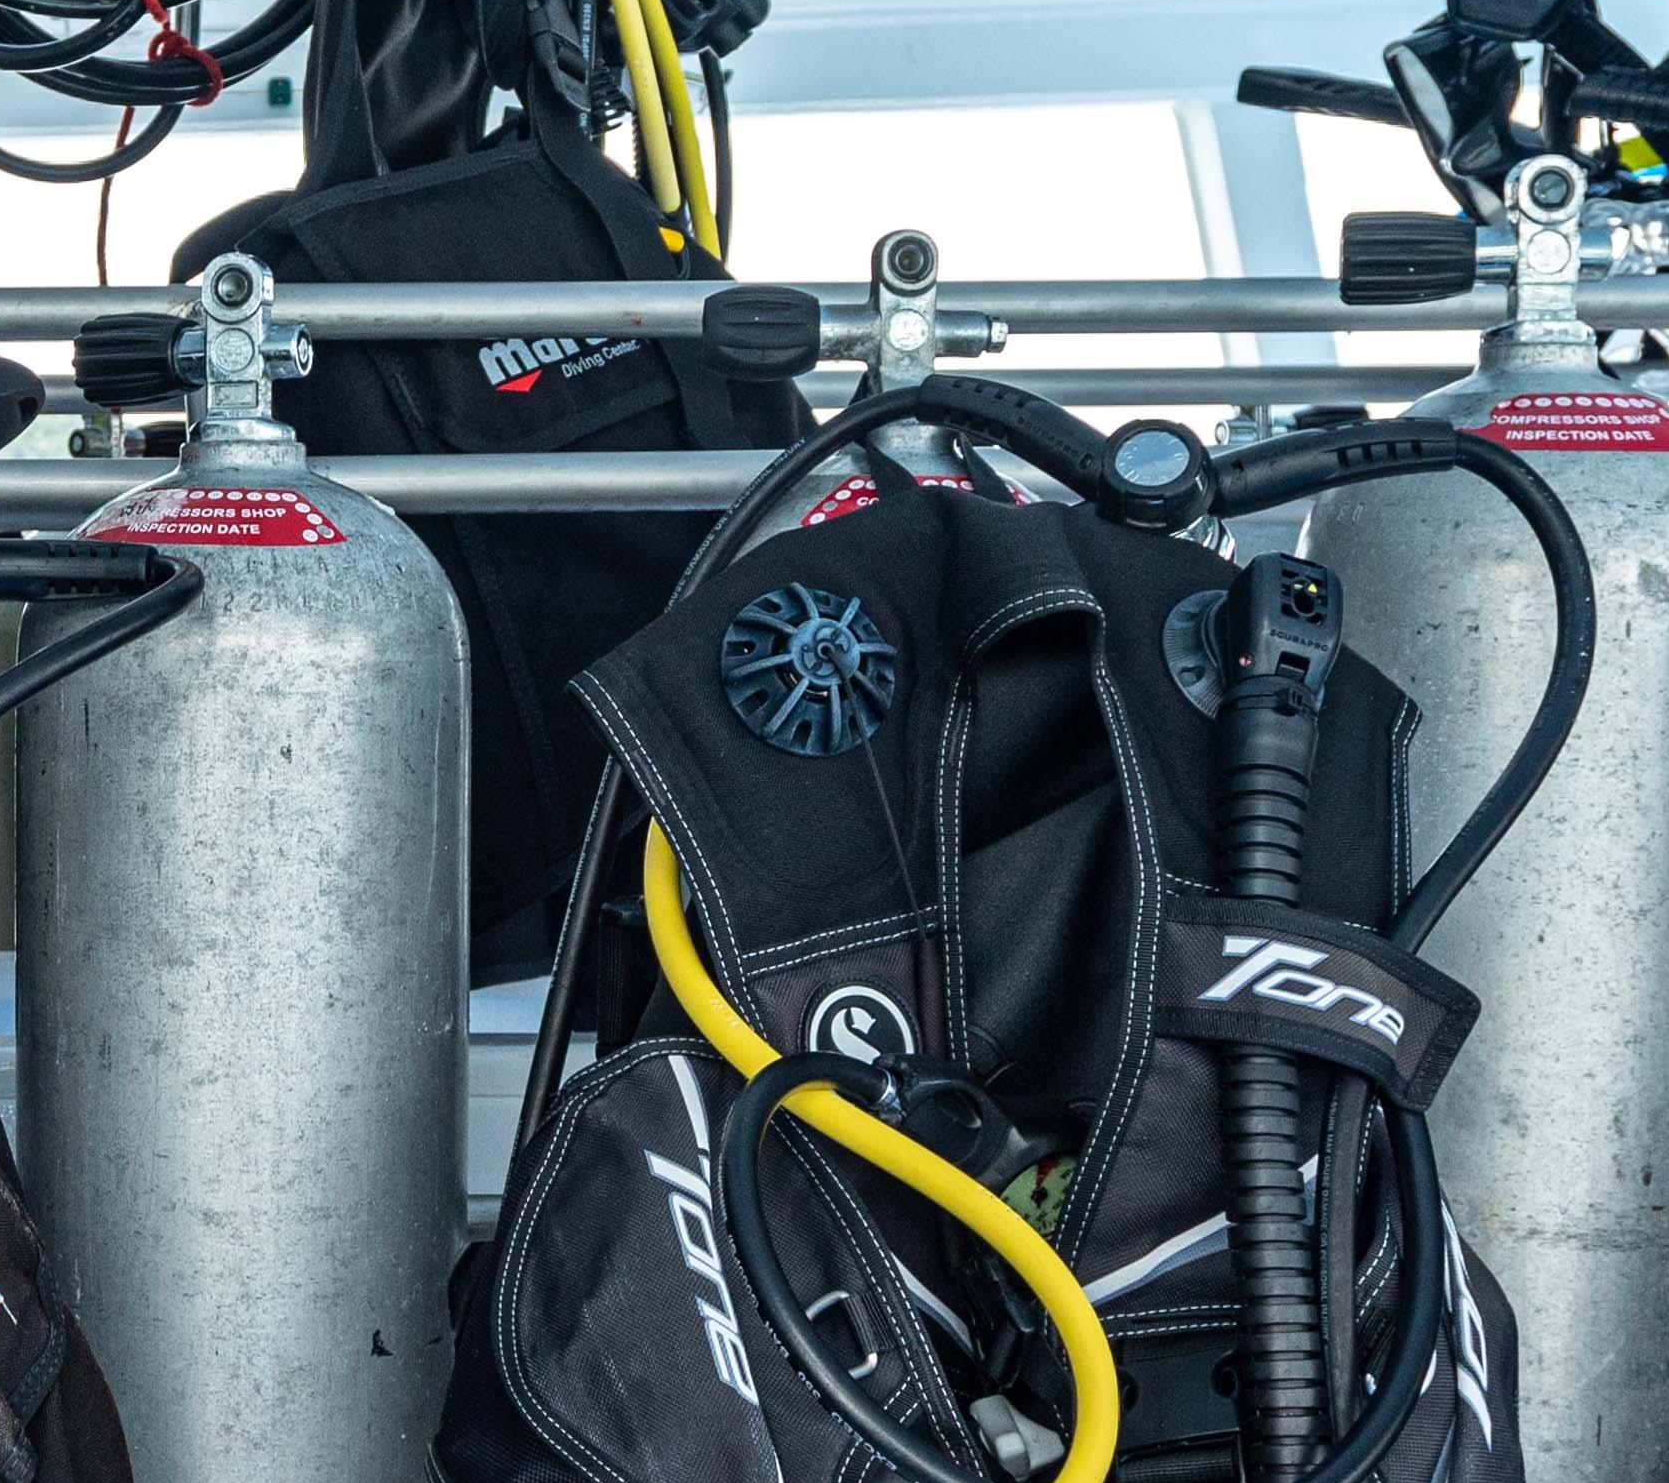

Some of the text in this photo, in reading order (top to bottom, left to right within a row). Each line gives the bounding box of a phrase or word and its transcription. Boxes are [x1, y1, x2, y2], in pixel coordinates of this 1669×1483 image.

[562, 339, 640, 379] Diving Center
[1625, 414, 1661, 426] SHOP
[1505, 429, 1656, 442] INSPECTION DATE
[240, 507, 287, 518] SHOP
[126, 522, 261, 535] INSPECTION DATE
[1269, 628, 1329, 652] SCUBAPRO
[1197, 934, 1404, 1046] Tone
[644, 1147, 759, 1407] Tone
